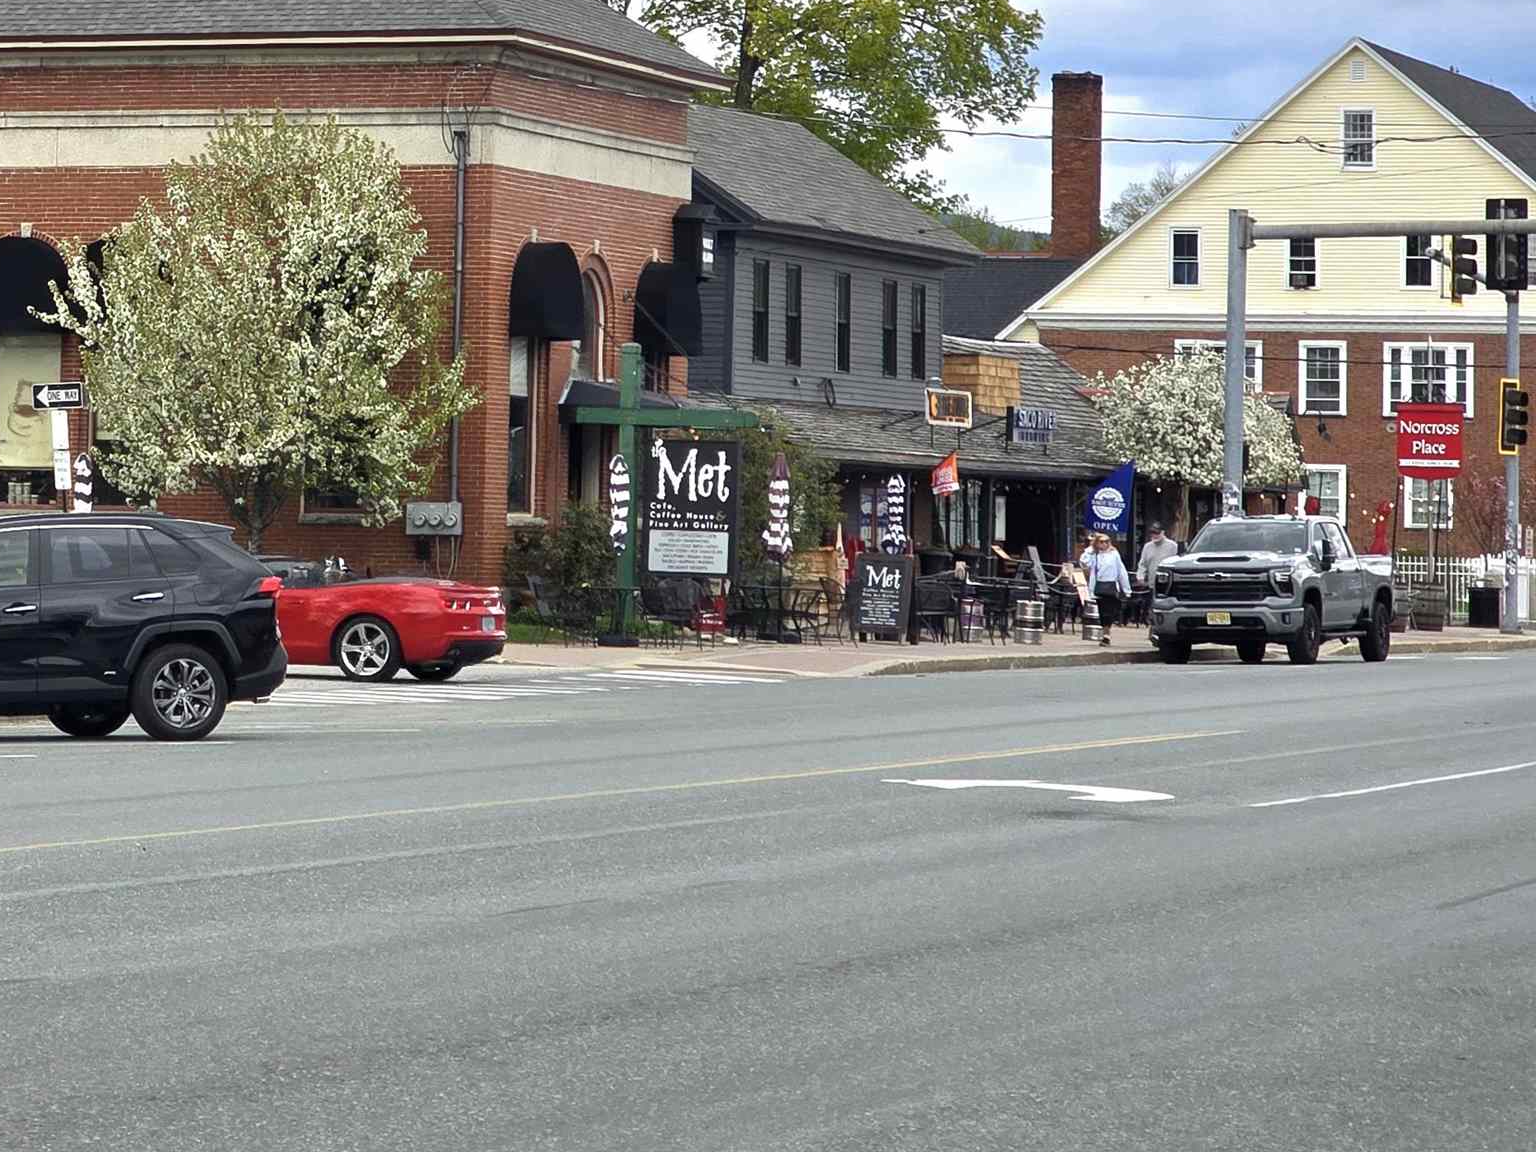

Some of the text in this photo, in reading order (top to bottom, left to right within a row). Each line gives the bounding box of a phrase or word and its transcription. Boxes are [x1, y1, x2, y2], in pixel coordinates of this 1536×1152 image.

[47, 391, 77, 401] ONE WAY
[1400, 420, 1460, 435] Norcross
[1412, 439, 1446, 455] Place
[656, 447, 731, 502] Met
[650, 511, 682, 519] Coffee
[686, 512, 714, 520] House
[649, 520, 669, 528] Fine
[693, 521, 729, 531] Gallery
[1094, 522, 1119, 531] OPEN
[866, 565, 902, 589] Met
